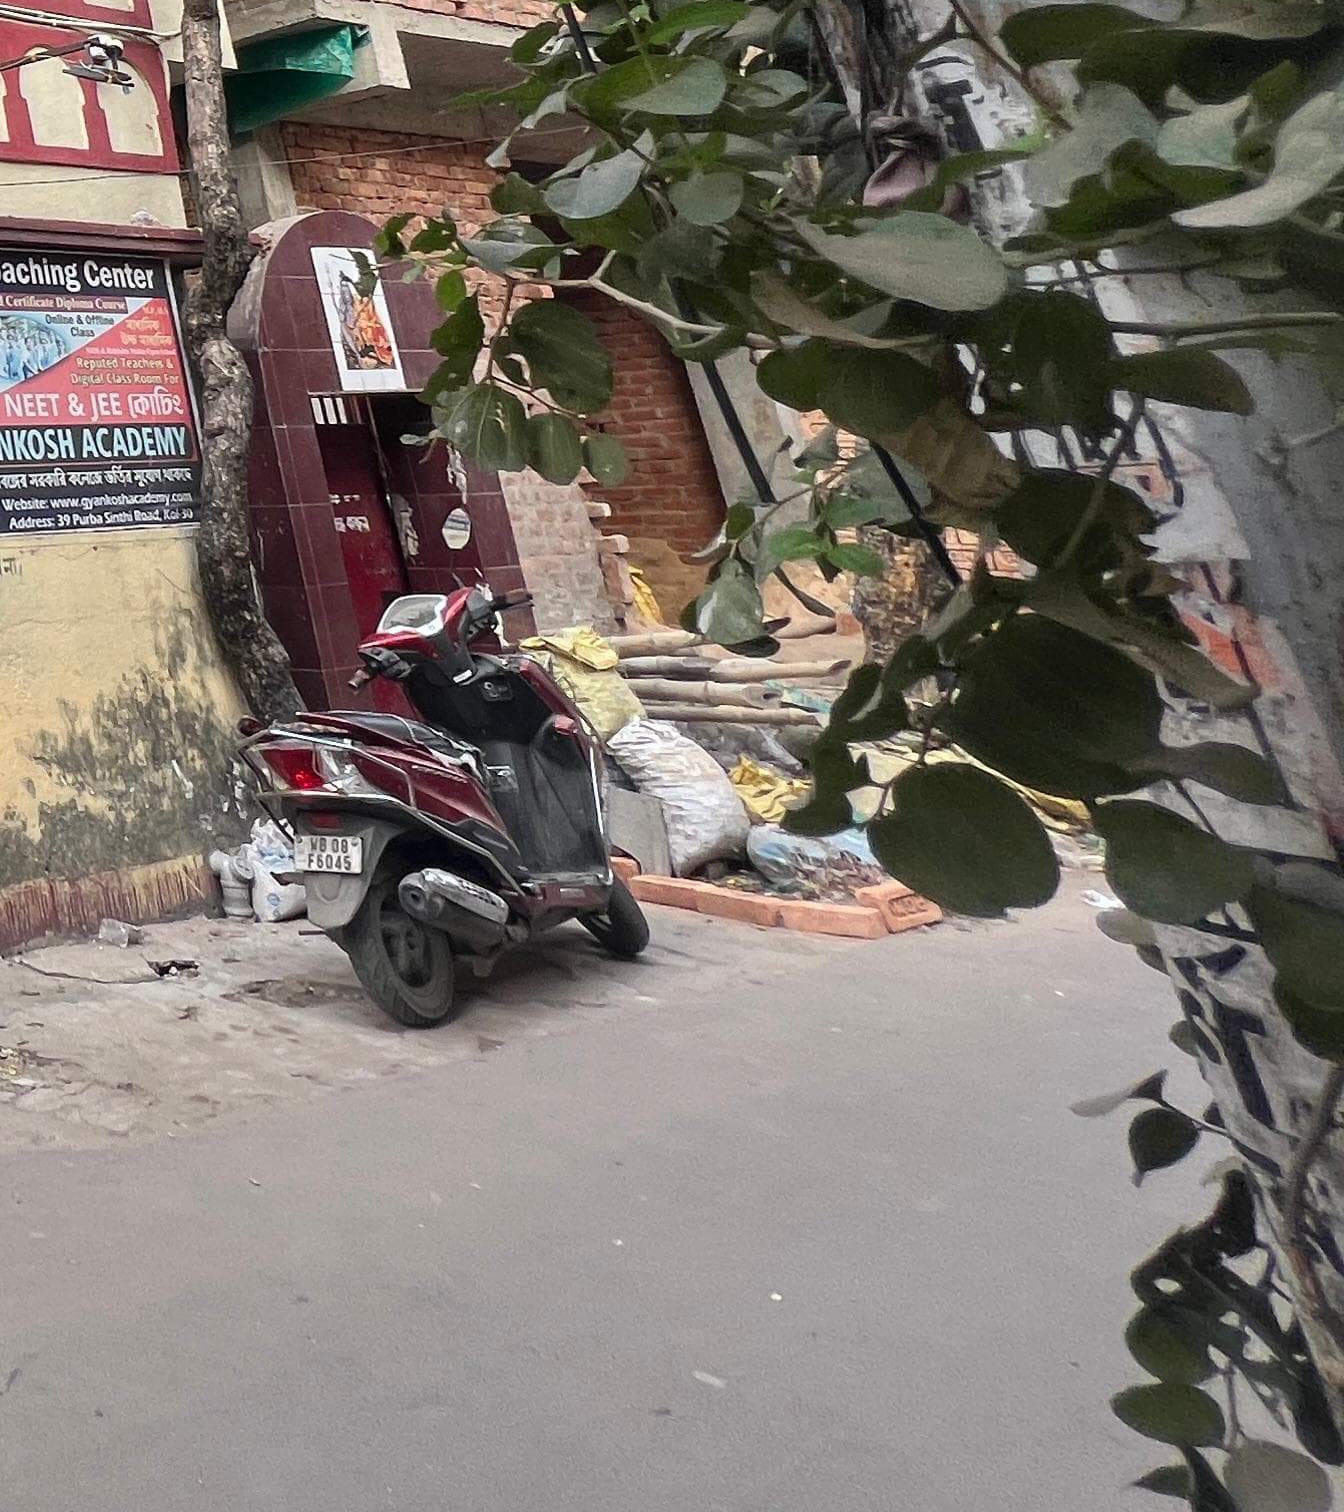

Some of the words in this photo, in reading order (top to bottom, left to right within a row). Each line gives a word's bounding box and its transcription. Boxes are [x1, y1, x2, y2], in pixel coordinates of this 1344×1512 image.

[84, 259, 154, 290] Center
[3, 392, 60, 419] NEET
[69, 393, 85, 417] &
[90, 391, 122, 422] JEE
[82, 426, 187, 460] ACADEMY
